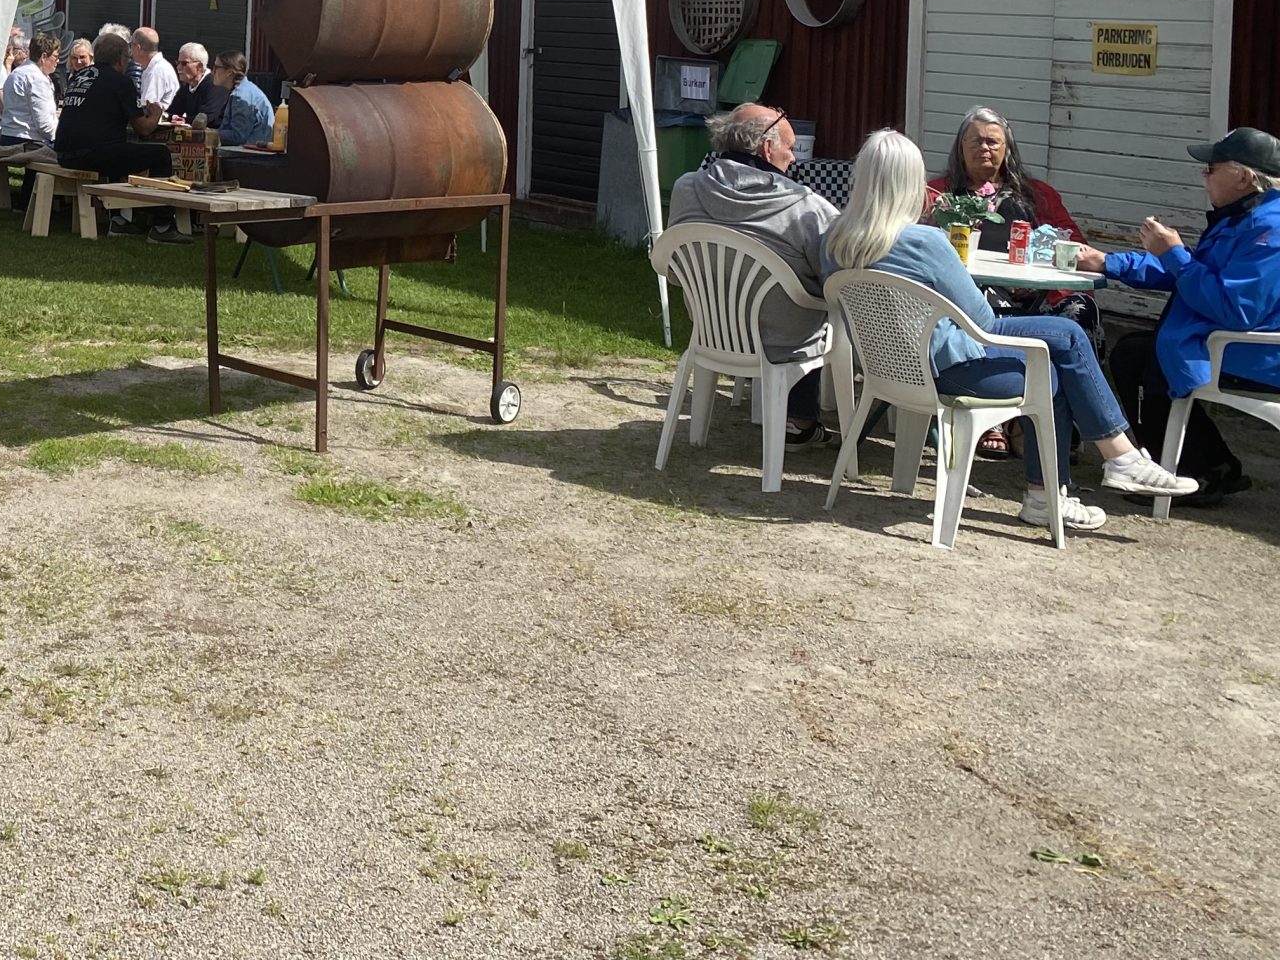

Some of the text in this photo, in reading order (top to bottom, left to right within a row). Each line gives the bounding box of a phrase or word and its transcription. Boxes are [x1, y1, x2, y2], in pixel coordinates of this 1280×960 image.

[1097, 28, 1152, 45] PARKERING
[1097, 49, 1151, 69] FÖRBJUDEN
[683, 78, 706, 88] Burkar
